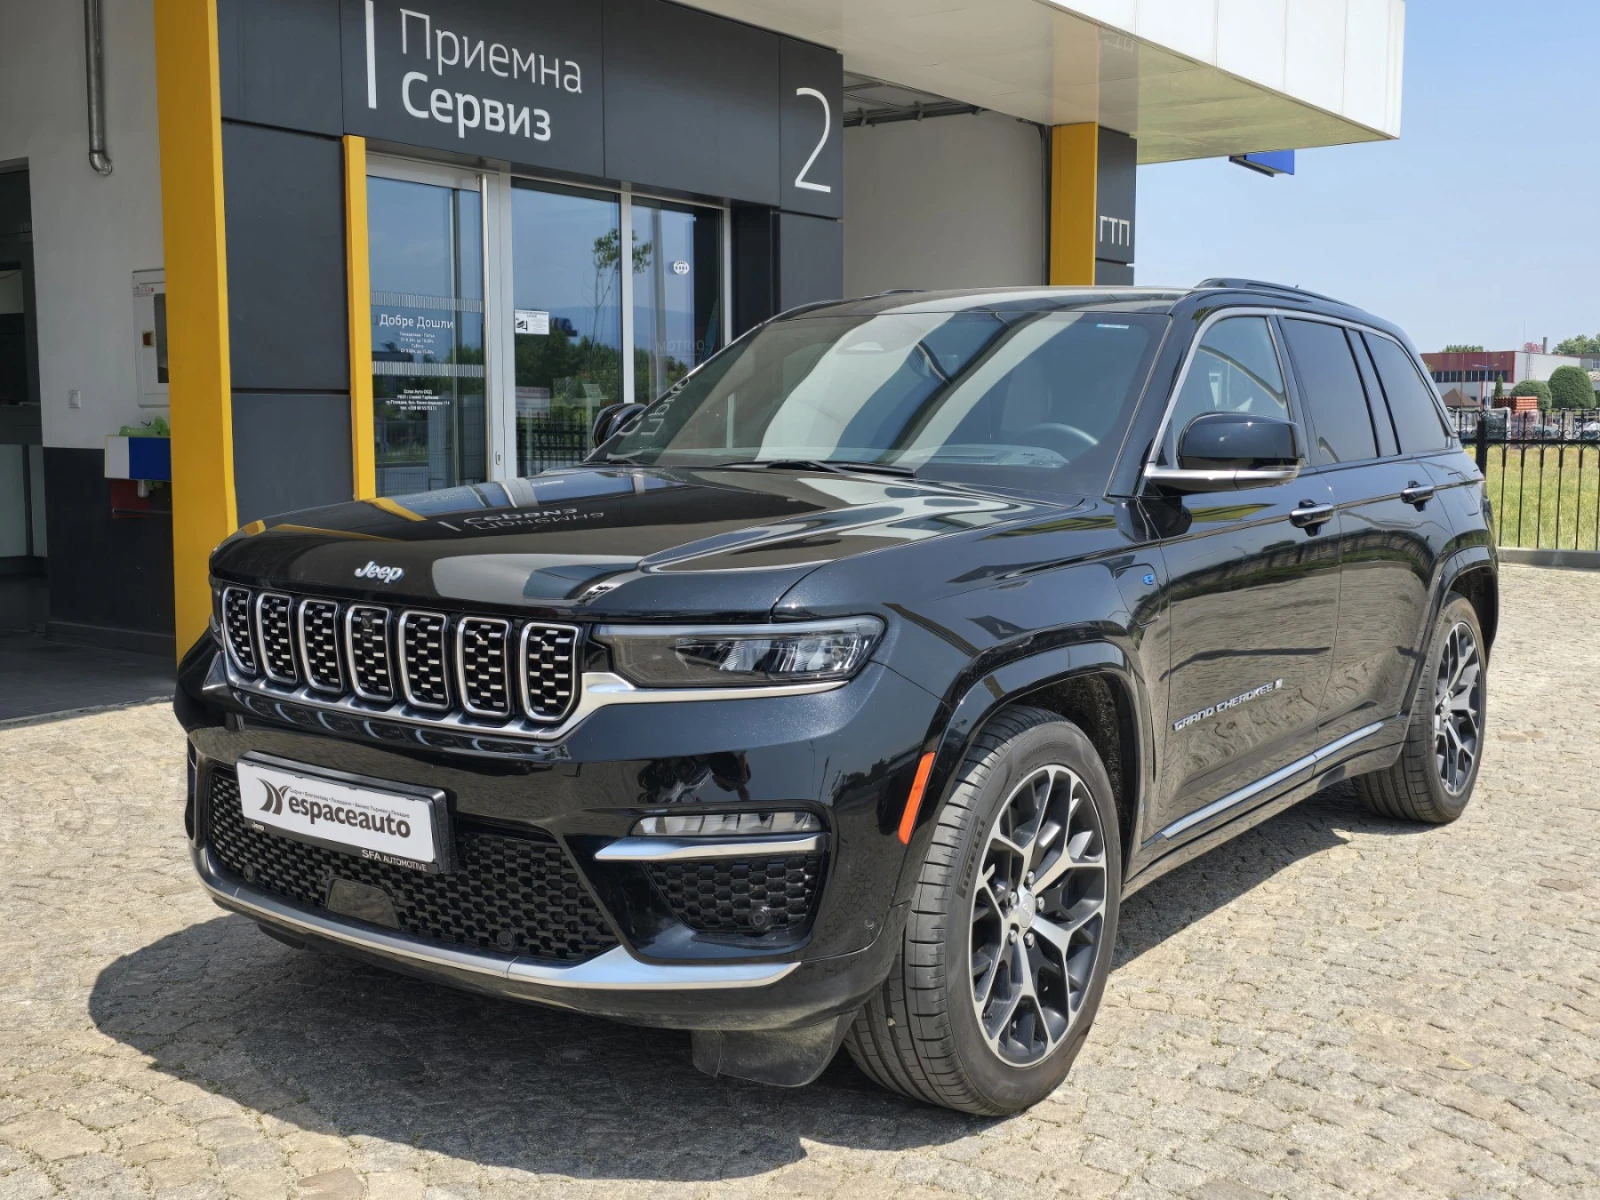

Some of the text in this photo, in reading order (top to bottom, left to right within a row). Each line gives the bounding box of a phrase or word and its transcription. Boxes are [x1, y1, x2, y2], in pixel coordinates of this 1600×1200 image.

[400, 8, 583, 94] Приемна
[402, 71, 551, 141] Сервиз
[794, 86, 832, 194] 2
[1099, 215, 1131, 247] ГТП
[379, 313, 454, 330] Добре Дошли
[657, 339, 704, 352] MOTRO
[354, 561, 404, 584] Jeep
[1173, 682, 1274, 731] GRAND CHEROKEE
[288, 796, 411, 838] espaceauto
[361, 849, 428, 872] SFA AUTOMOTIVE
